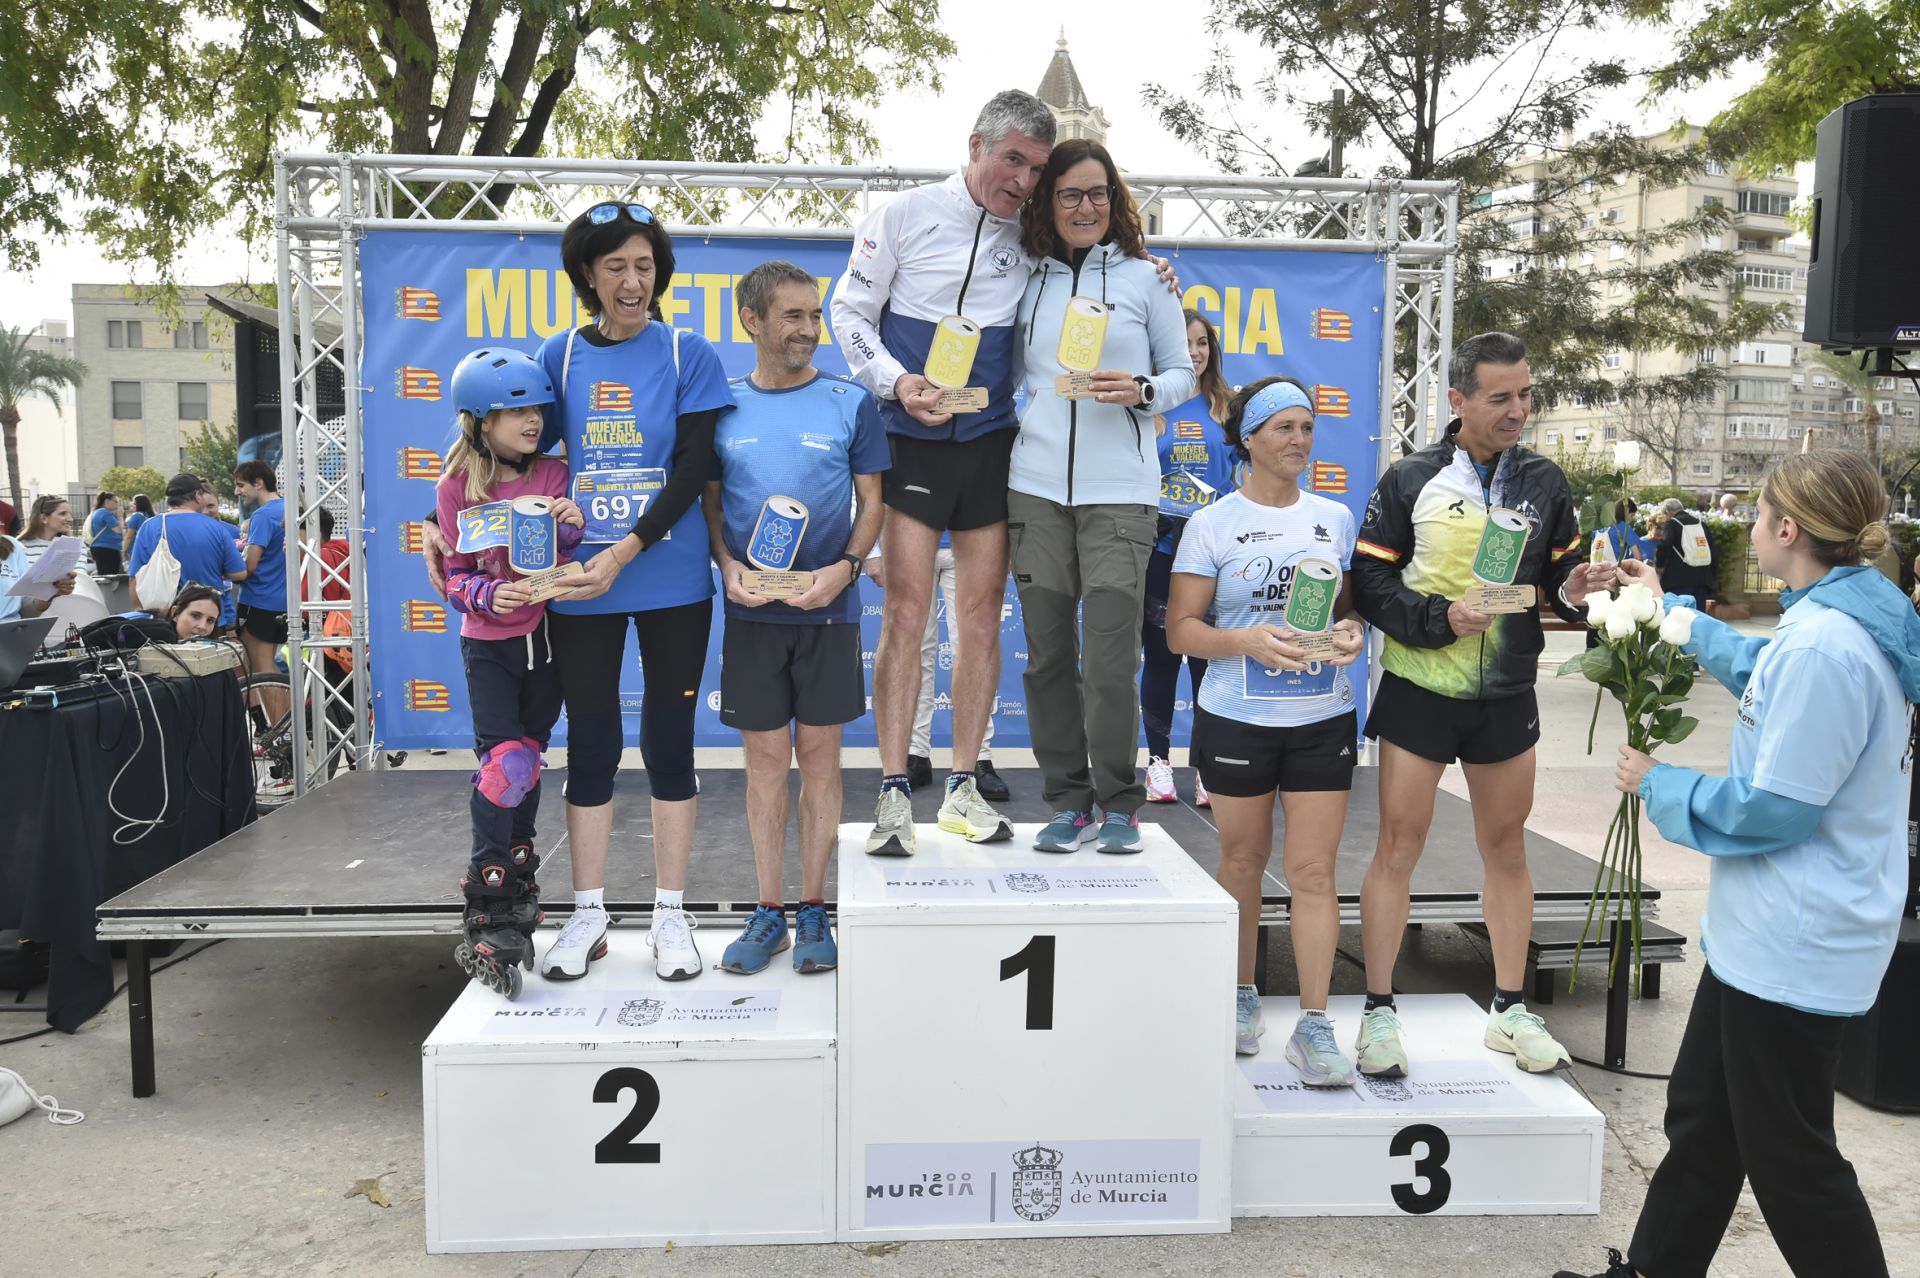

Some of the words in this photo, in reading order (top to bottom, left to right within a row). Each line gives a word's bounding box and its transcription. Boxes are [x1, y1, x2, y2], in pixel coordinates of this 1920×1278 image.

[466, 268, 753, 344] MUET
[586, 419, 636, 434] MUÉVETE
[582, 434, 588, 446] X
[590, 432, 644, 445] VALENCIA
[1174, 442, 1206, 454] MUÉVETE
[1170, 454, 1174, 462] X
[1176, 453, 1210, 462] VALENCIA
[1160, 482, 1210, 506] 2330
[591, 494, 650, 520] 697
[468, 515, 507, 541] 22
[1252, 588, 1264, 598] mi
[1267, 584, 1290, 600] DES
[862, 606, 883, 615] OBAL
[1264, 603, 1285, 612] VALENC
[1015, 652, 1028, 660] Reg
[1000, 935, 1056, 1030] 1
[1411, 1079, 1511, 1089] Ayuntamiento
[1438, 1087, 1496, 1096] Murcia
[592, 1067, 661, 1164] 2
[1389, 1124, 1451, 1214] 3
[922, 1172, 972, 1182] 1200
[1070, 1170, 1198, 1187] Ayuntamiento
[866, 1182, 974, 1198] MURCIA
[1070, 1190, 1092, 1203] de
[1098, 1189, 1168, 1203] Murcia
